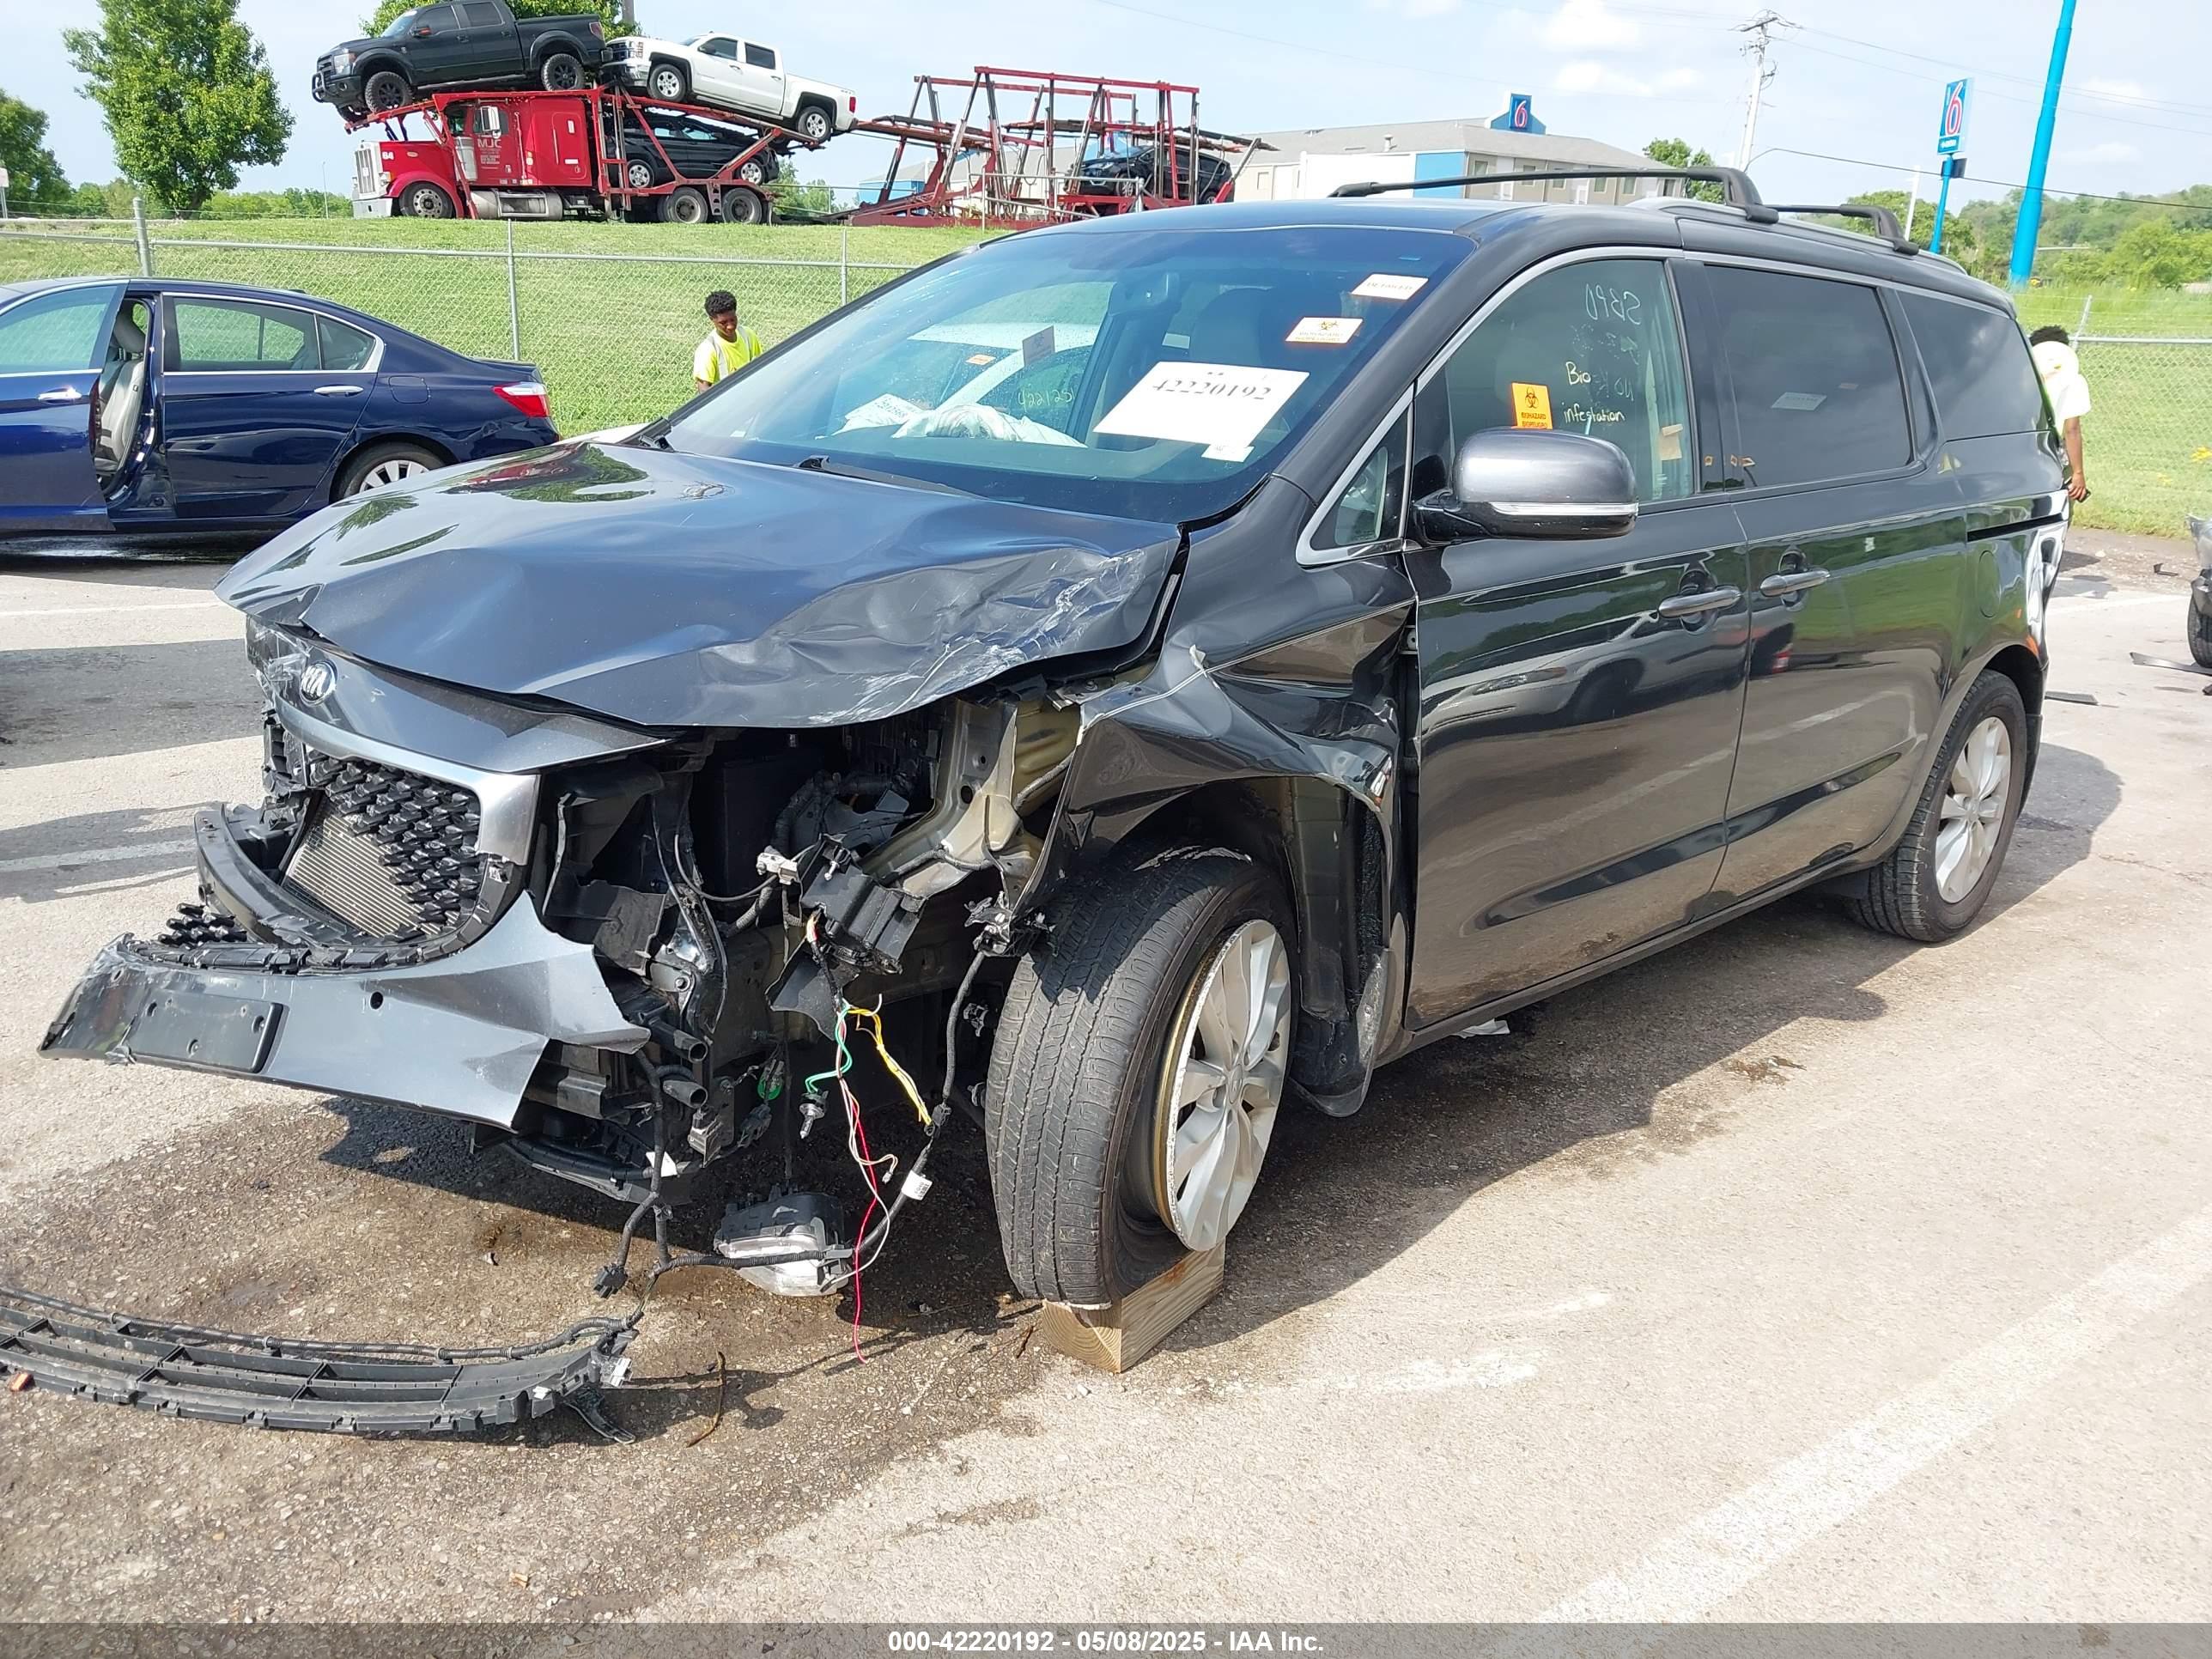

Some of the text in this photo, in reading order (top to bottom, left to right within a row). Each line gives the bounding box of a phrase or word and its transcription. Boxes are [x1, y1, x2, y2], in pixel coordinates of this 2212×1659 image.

[1516, 100, 1528, 128] 6
[1946, 81, 1963, 135] 6
[477, 138, 501, 149] MJC
[1565, 361, 1591, 386] Bio
[1152, 380, 1272, 400] 42220192
[1561, 401, 1626, 423] infestation
